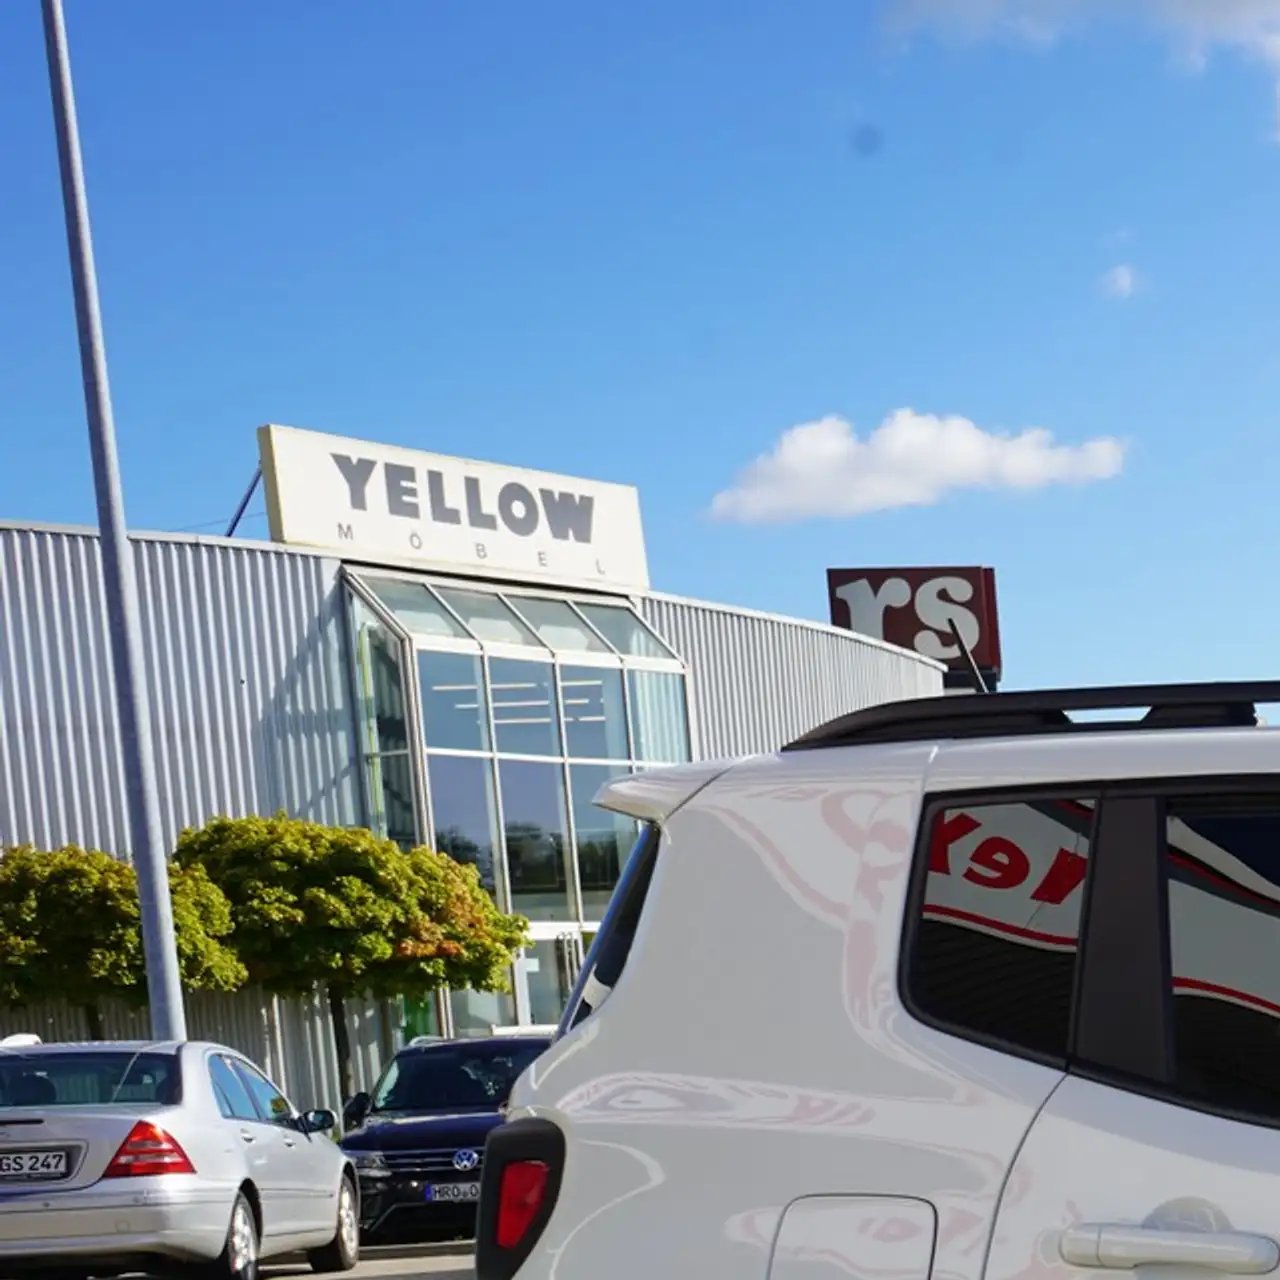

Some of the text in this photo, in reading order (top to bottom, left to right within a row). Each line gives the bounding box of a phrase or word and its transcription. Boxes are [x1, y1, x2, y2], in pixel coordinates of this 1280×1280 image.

[330, 453, 594, 544] YELLOW
[337, 522, 606, 576] MÖBEL
[835, 575, 980, 660] rs
[0, 1154, 63, 1172] GS 247
